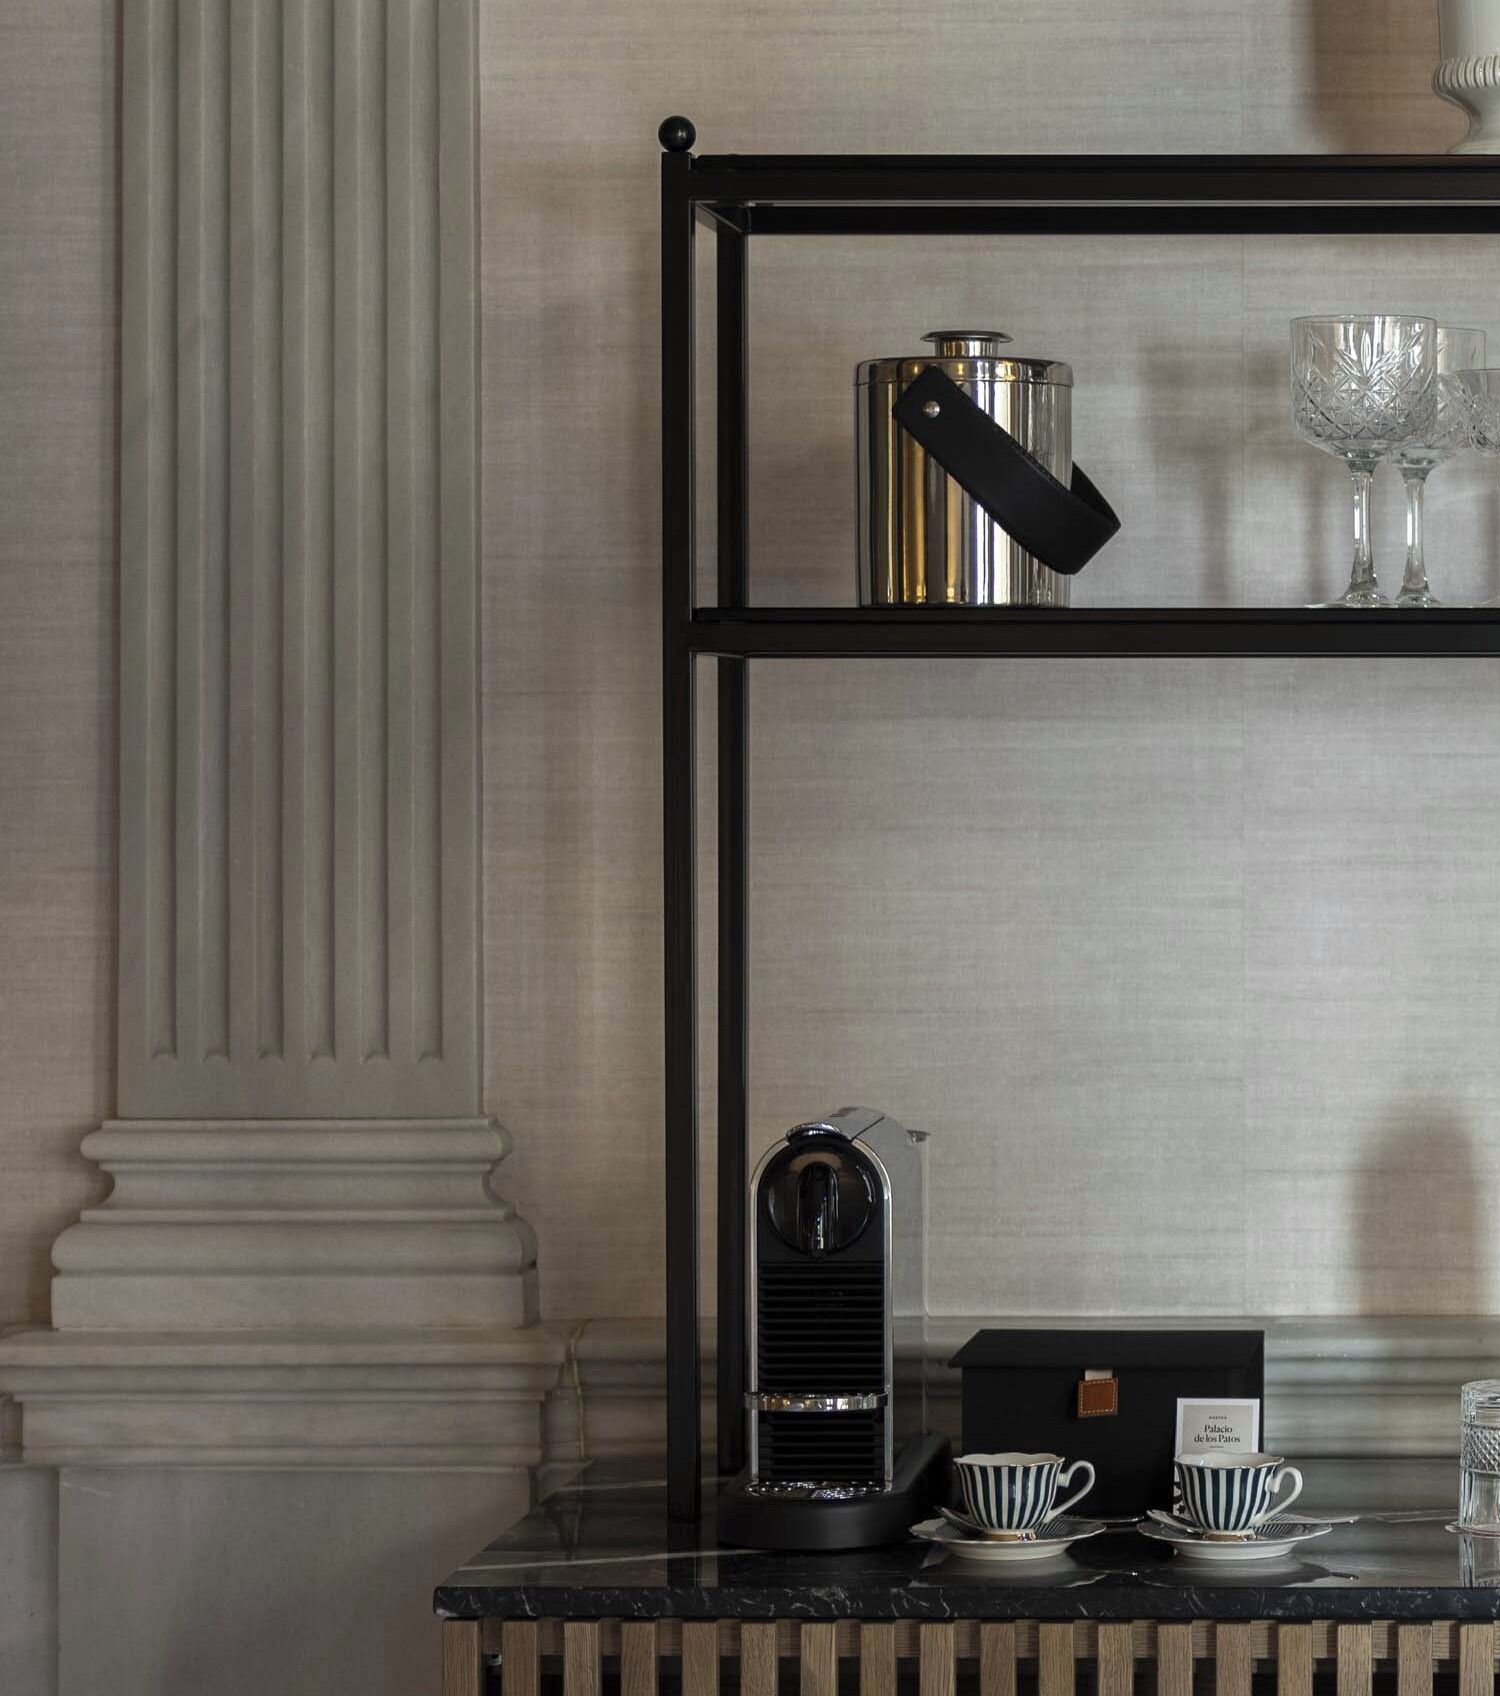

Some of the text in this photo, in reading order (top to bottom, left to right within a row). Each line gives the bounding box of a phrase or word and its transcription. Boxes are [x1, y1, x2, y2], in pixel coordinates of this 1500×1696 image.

[1204, 1424, 1233, 1433] Palacio
[1194, 1434, 1240, 1443] de los Patos
